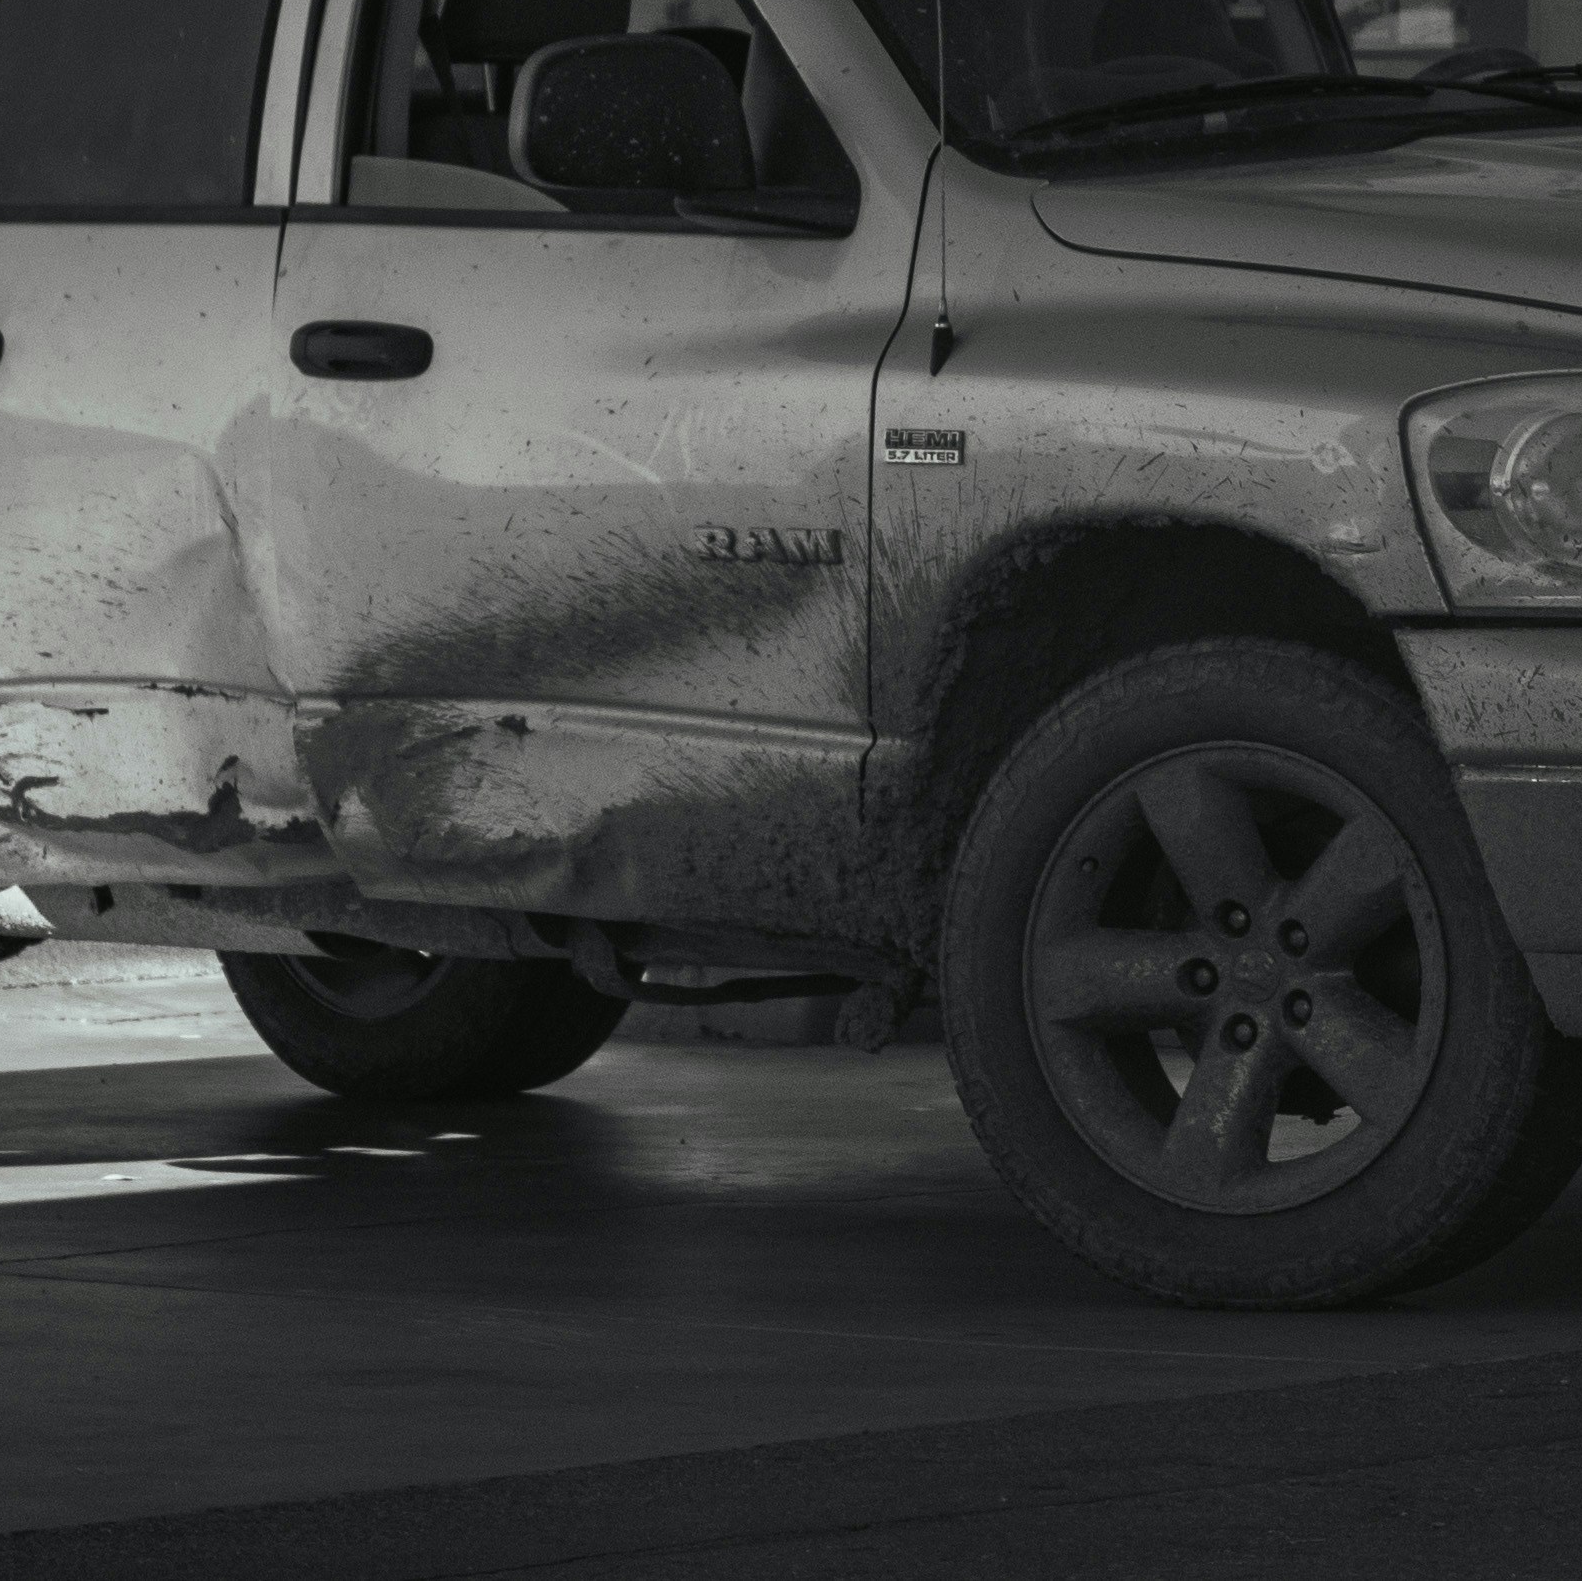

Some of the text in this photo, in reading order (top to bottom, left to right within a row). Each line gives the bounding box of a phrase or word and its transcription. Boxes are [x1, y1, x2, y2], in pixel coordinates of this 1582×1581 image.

[885, 429, 959, 448] HEMI
[888, 450, 956, 462] 5.7 LITER
[694, 525, 844, 566] RAM
